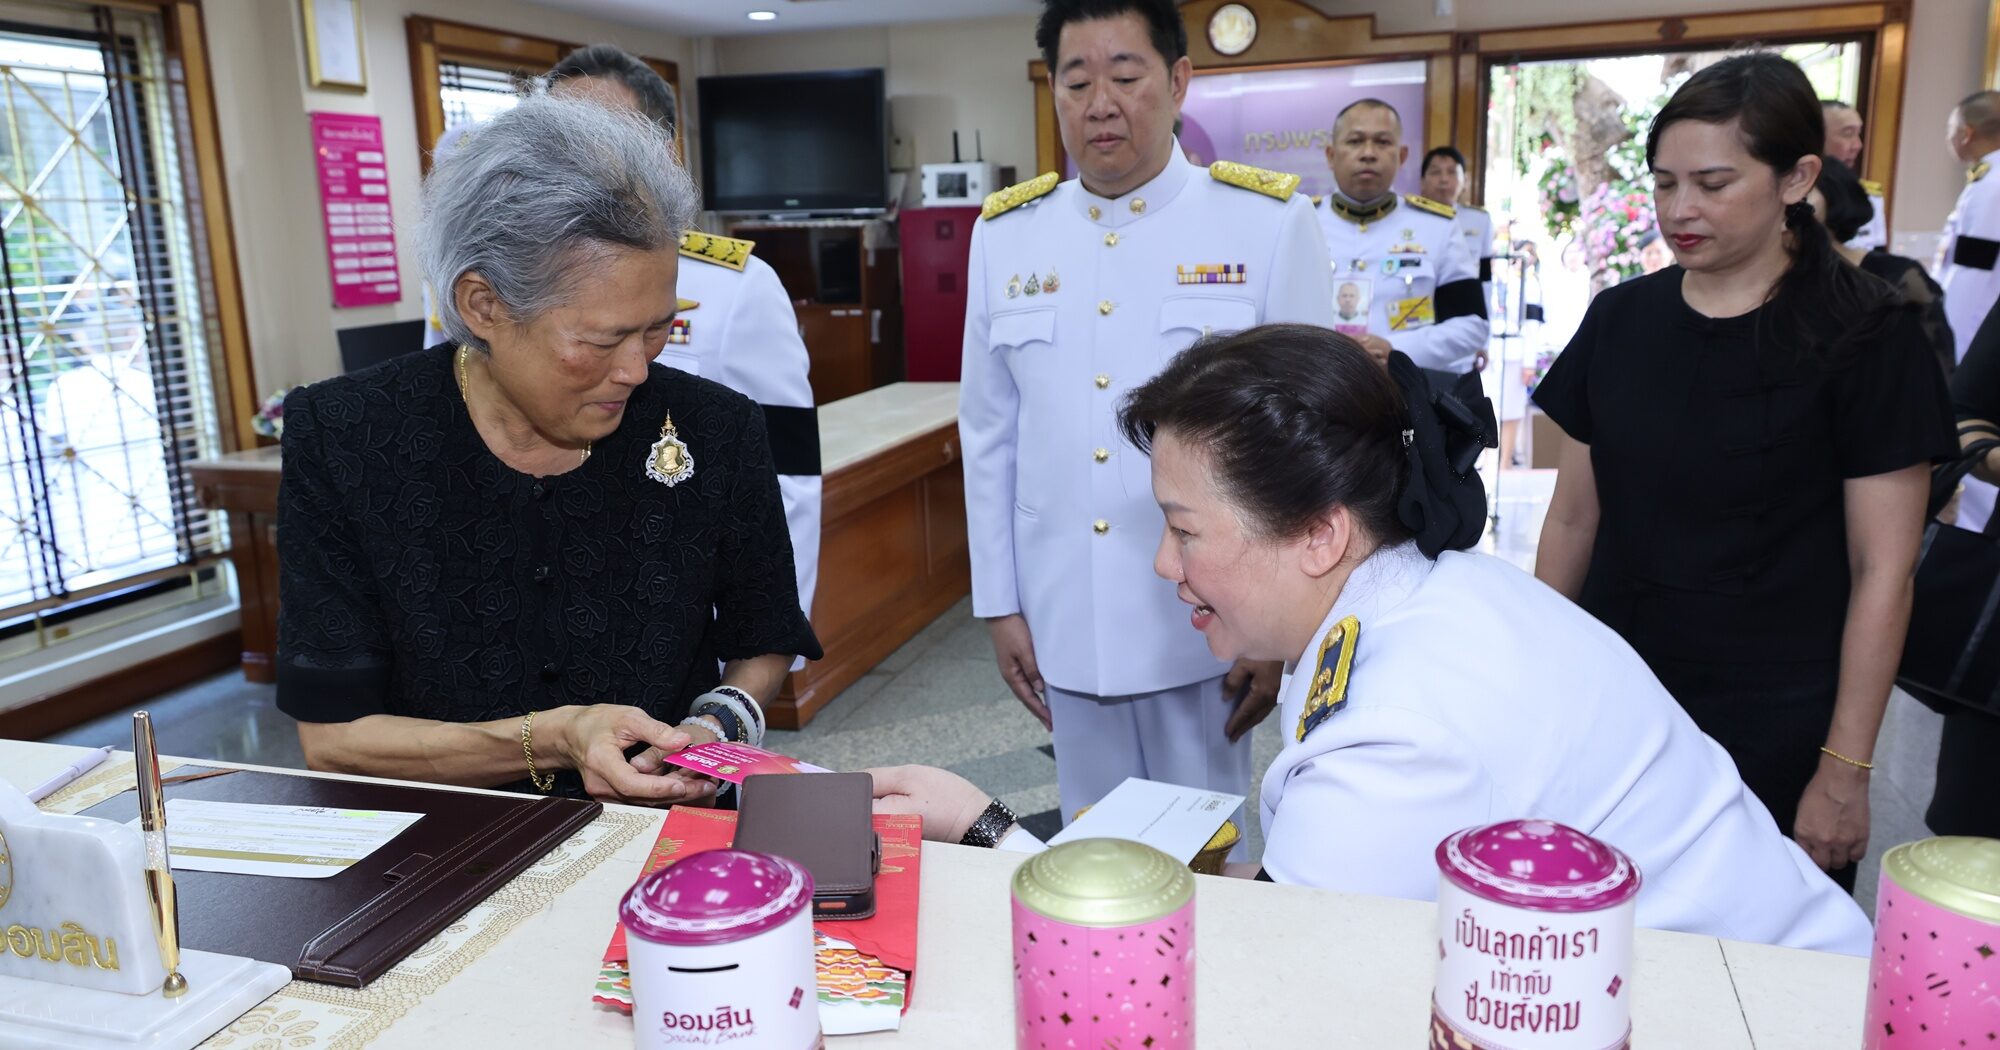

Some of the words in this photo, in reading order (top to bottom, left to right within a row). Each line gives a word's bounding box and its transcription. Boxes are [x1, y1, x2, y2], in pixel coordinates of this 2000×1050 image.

[1244, 128, 1331, 153] ทรงพร
[1455, 908, 1599, 964] เป็นลูกค้าเรา
[1491, 966, 1551, 995] เท่ากับ
[663, 1005, 753, 1031] ออมสิน
[1465, 980, 1581, 1033] ช่วยสังคม
[659, 1027, 711, 1045] Social
[715, 1023, 758, 1045] Bank
